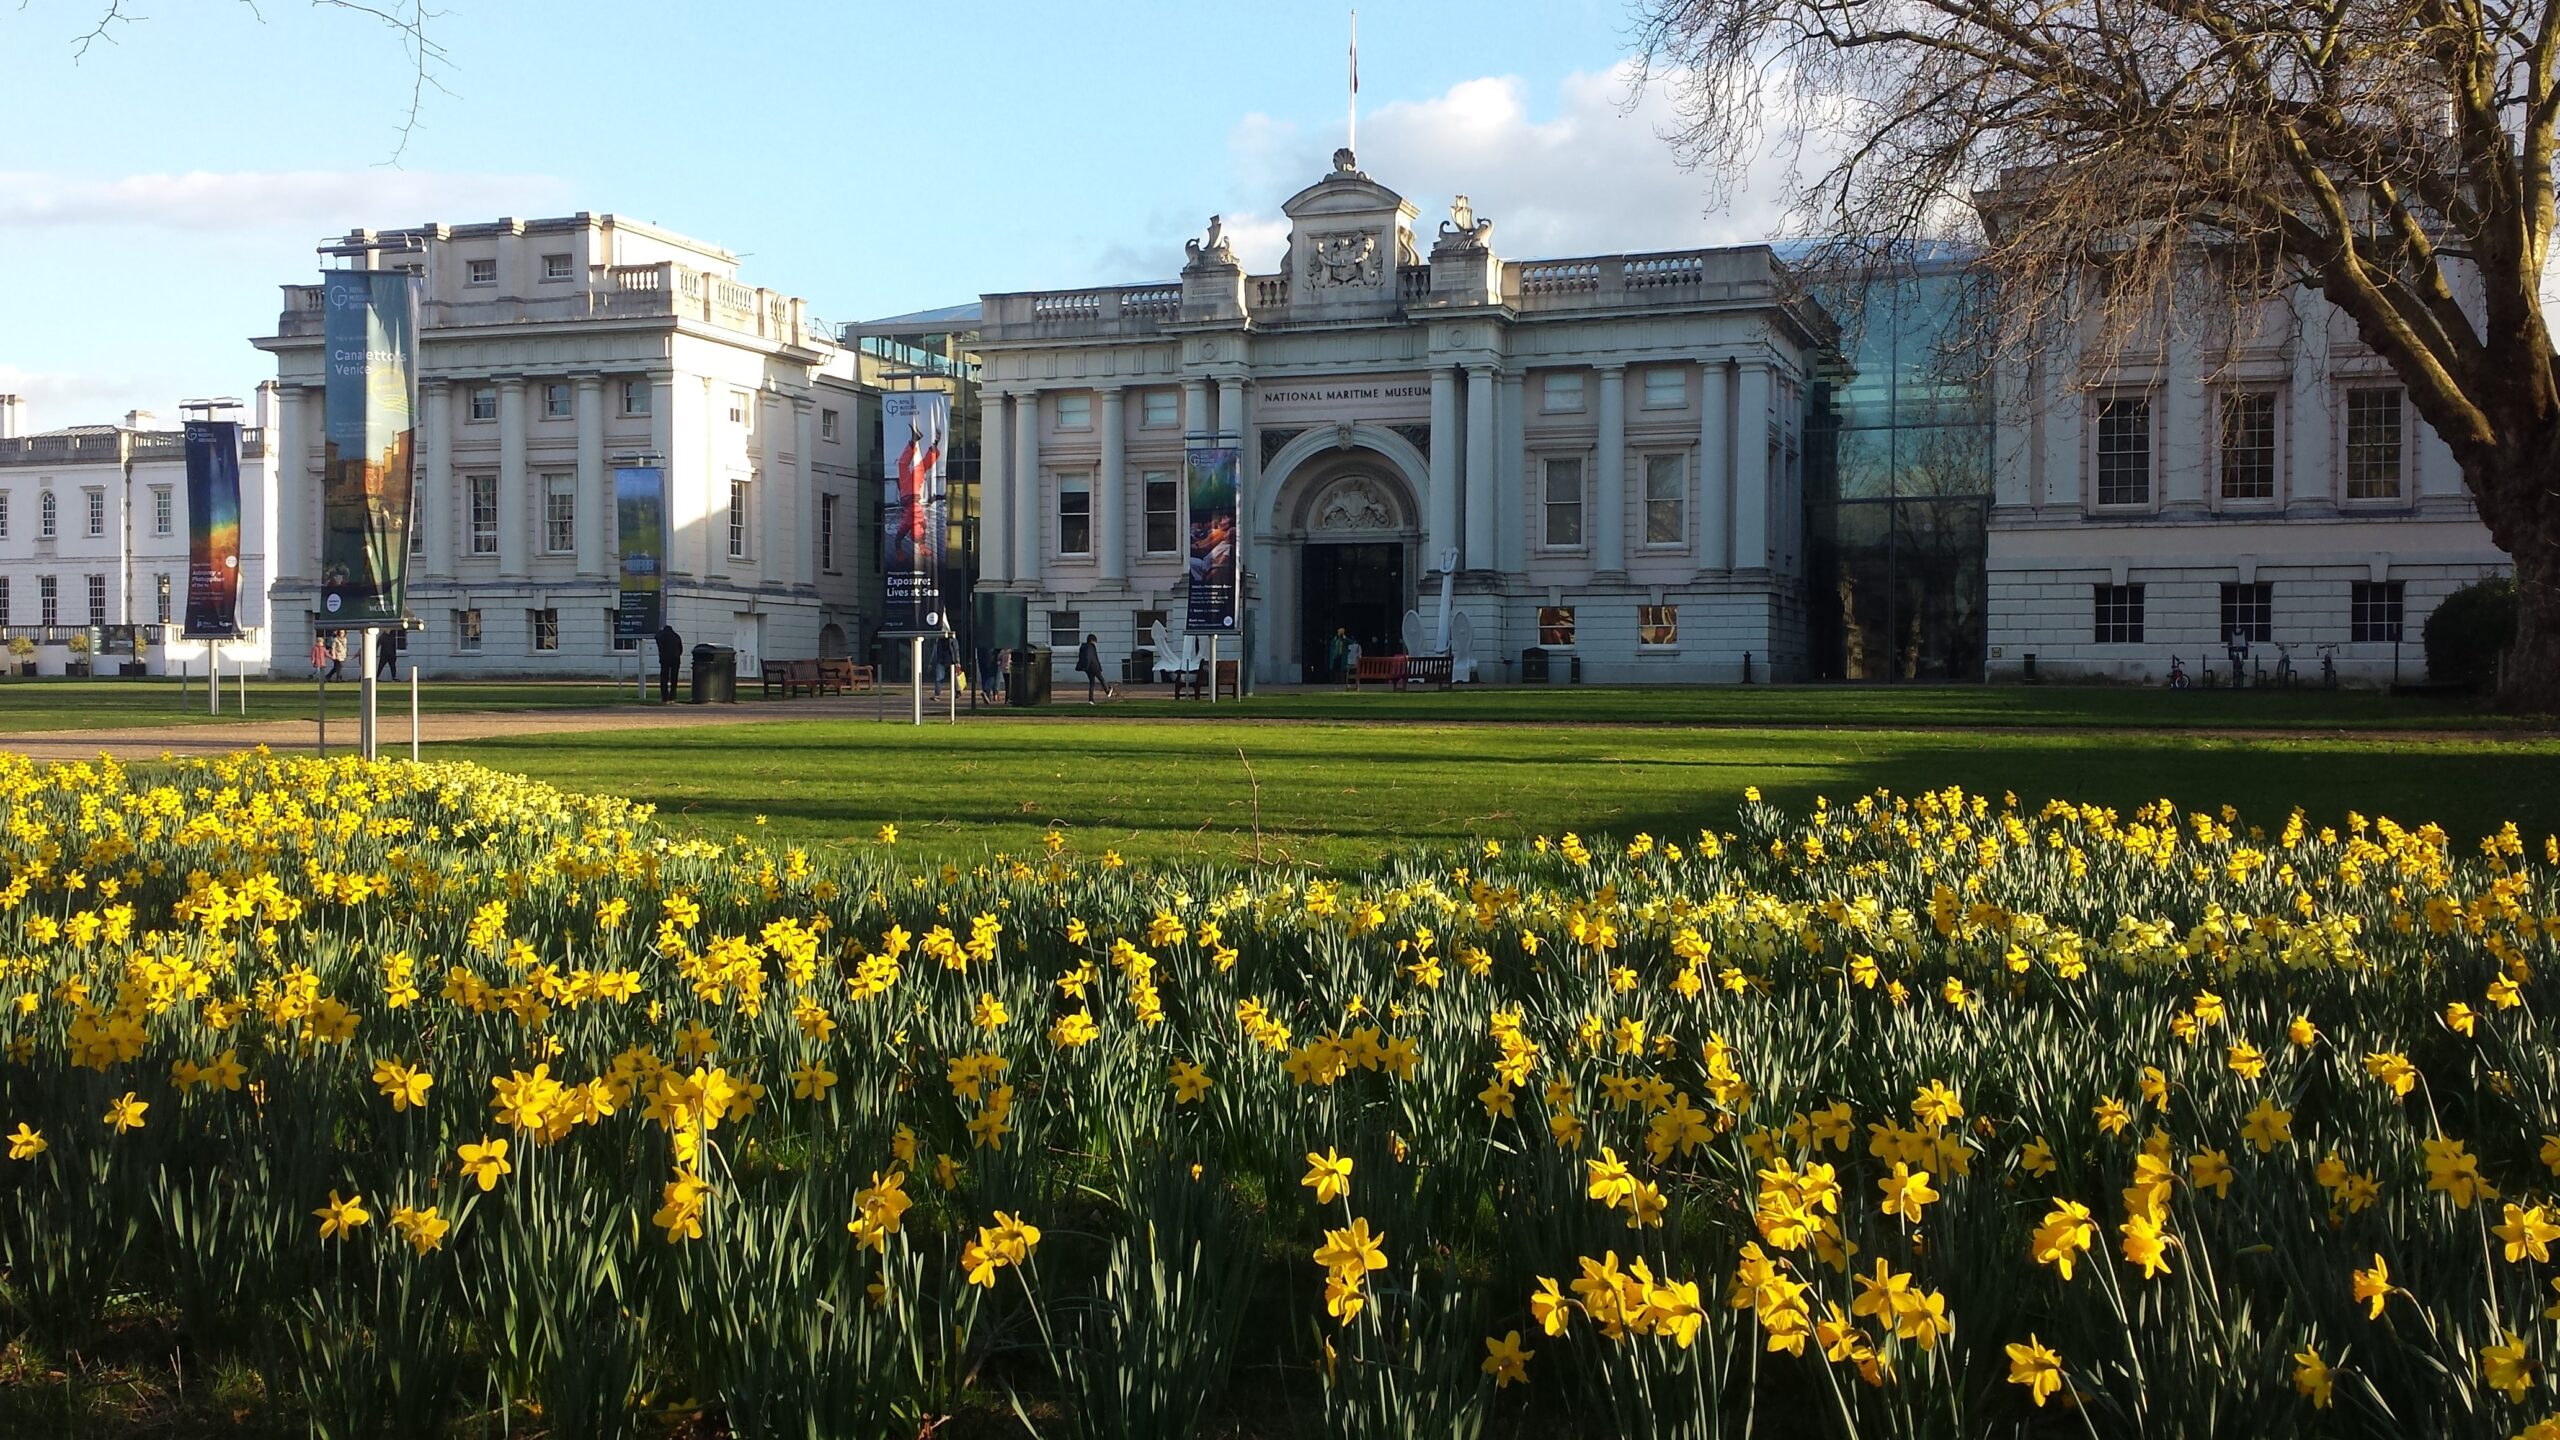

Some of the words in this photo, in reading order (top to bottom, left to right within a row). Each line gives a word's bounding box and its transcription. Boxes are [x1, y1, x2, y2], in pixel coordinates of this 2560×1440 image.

[335, 363, 372, 375] Venice
[1265, 391, 1322, 402] NATIONAL
[1327, 388, 1379, 400] MARITIME
[1385, 387, 1431, 397] MUSEUM
[887, 577, 931, 587] Exposure:
[887, 587, 909, 597] Lives
[910, 588, 920, 597] at
[922, 588, 939, 597] Sea
